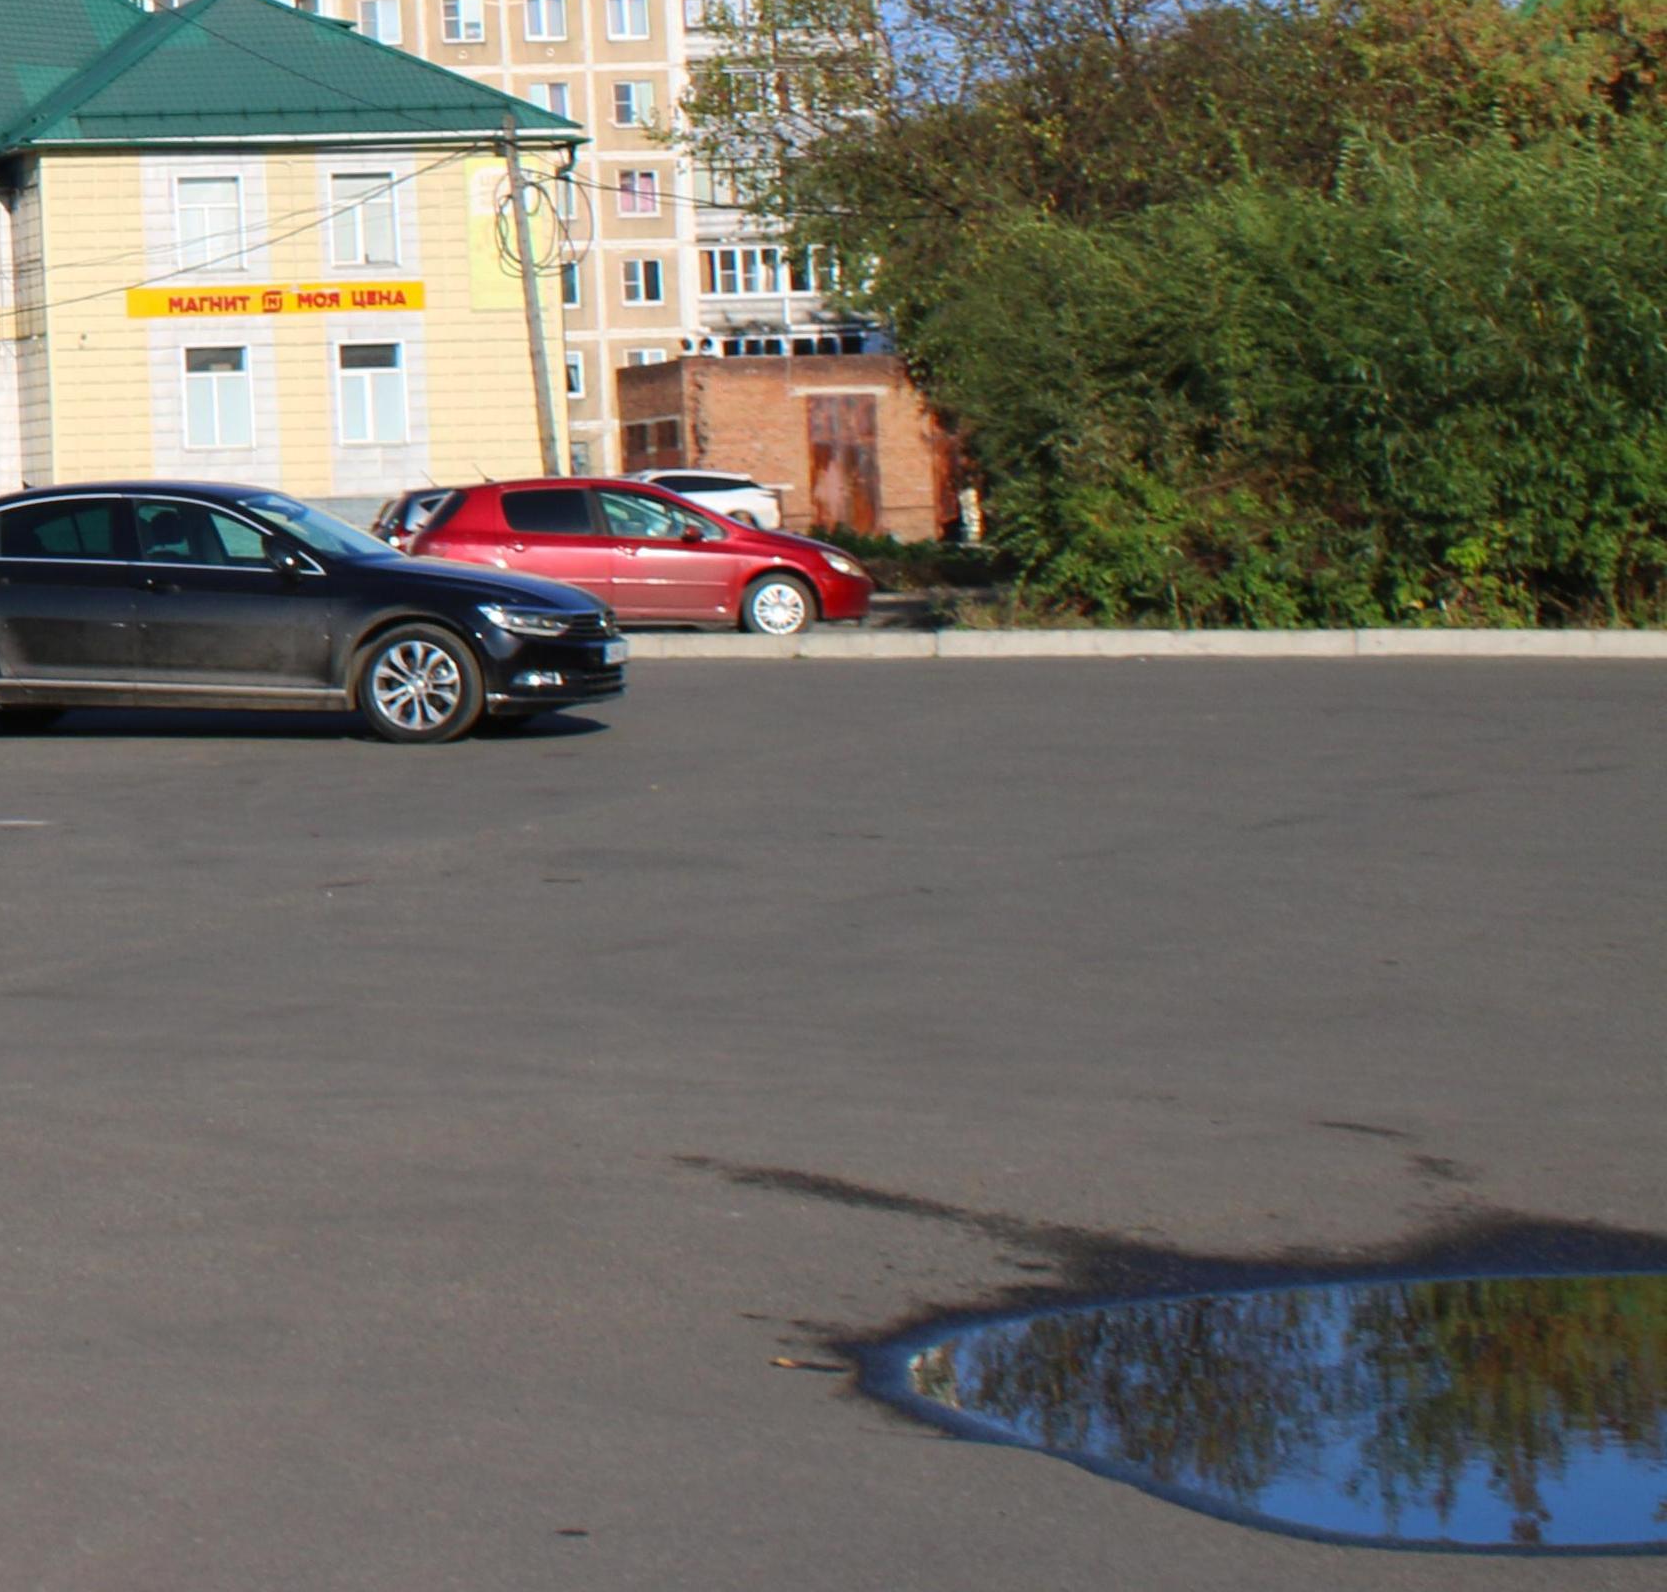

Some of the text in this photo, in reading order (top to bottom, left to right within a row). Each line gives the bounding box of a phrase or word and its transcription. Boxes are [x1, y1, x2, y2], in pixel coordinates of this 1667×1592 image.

[168, 295, 250, 314] МАГНИТ
[297, 291, 341, 309] МОЯ
[351, 289, 407, 307] ЦЕНА
